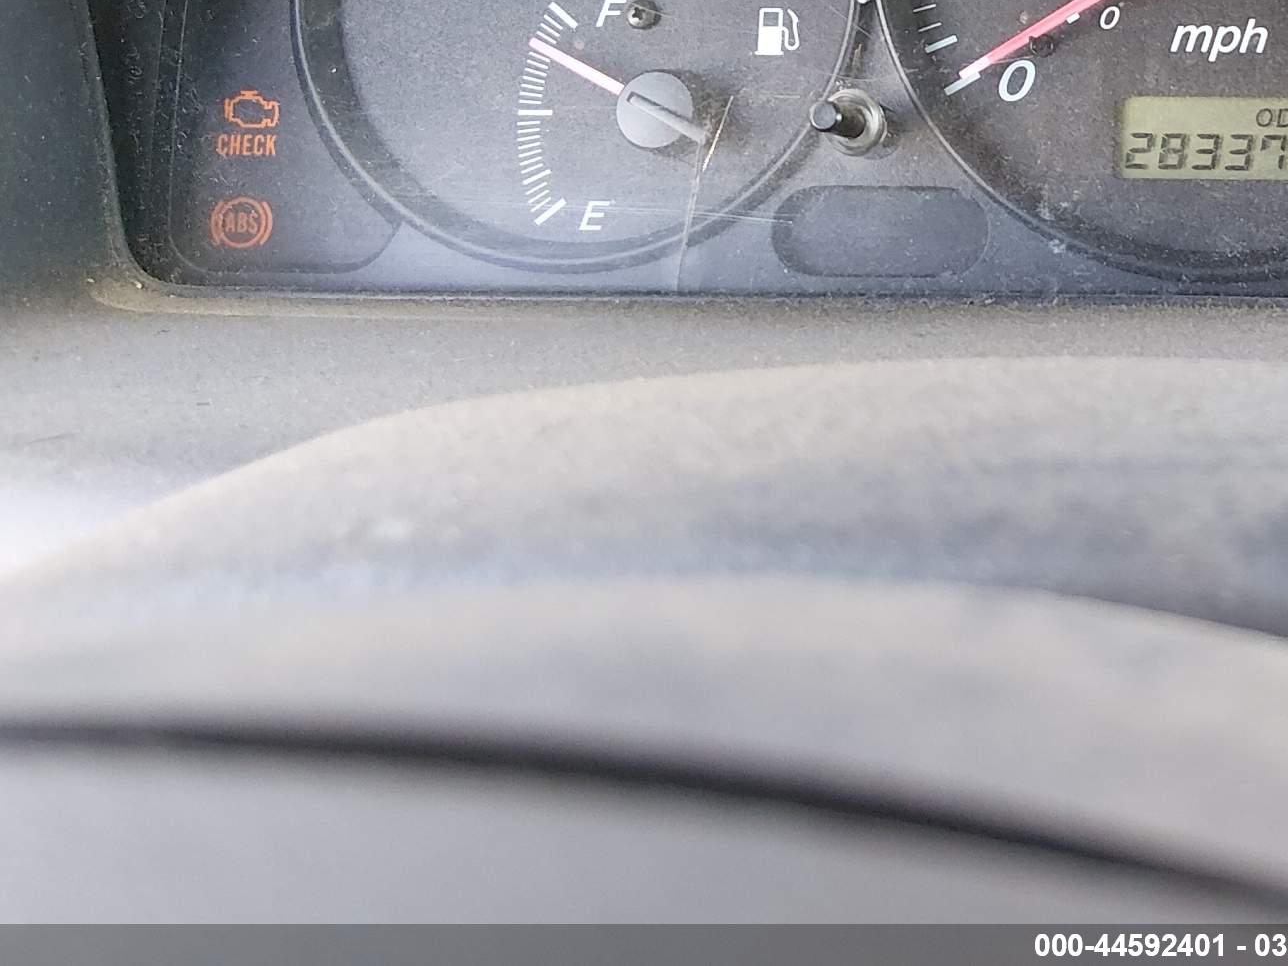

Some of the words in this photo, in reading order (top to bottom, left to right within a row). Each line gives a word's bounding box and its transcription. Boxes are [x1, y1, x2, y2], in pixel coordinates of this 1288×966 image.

[1100, 7, 1120, 29] 0
[1171, 19, 1268, 61] mph
[999, 60, 1035, 101] 0
[217, 134, 276, 155] CHECK
[225, 212, 258, 233] ABS
[579, 201, 606, 230] E
